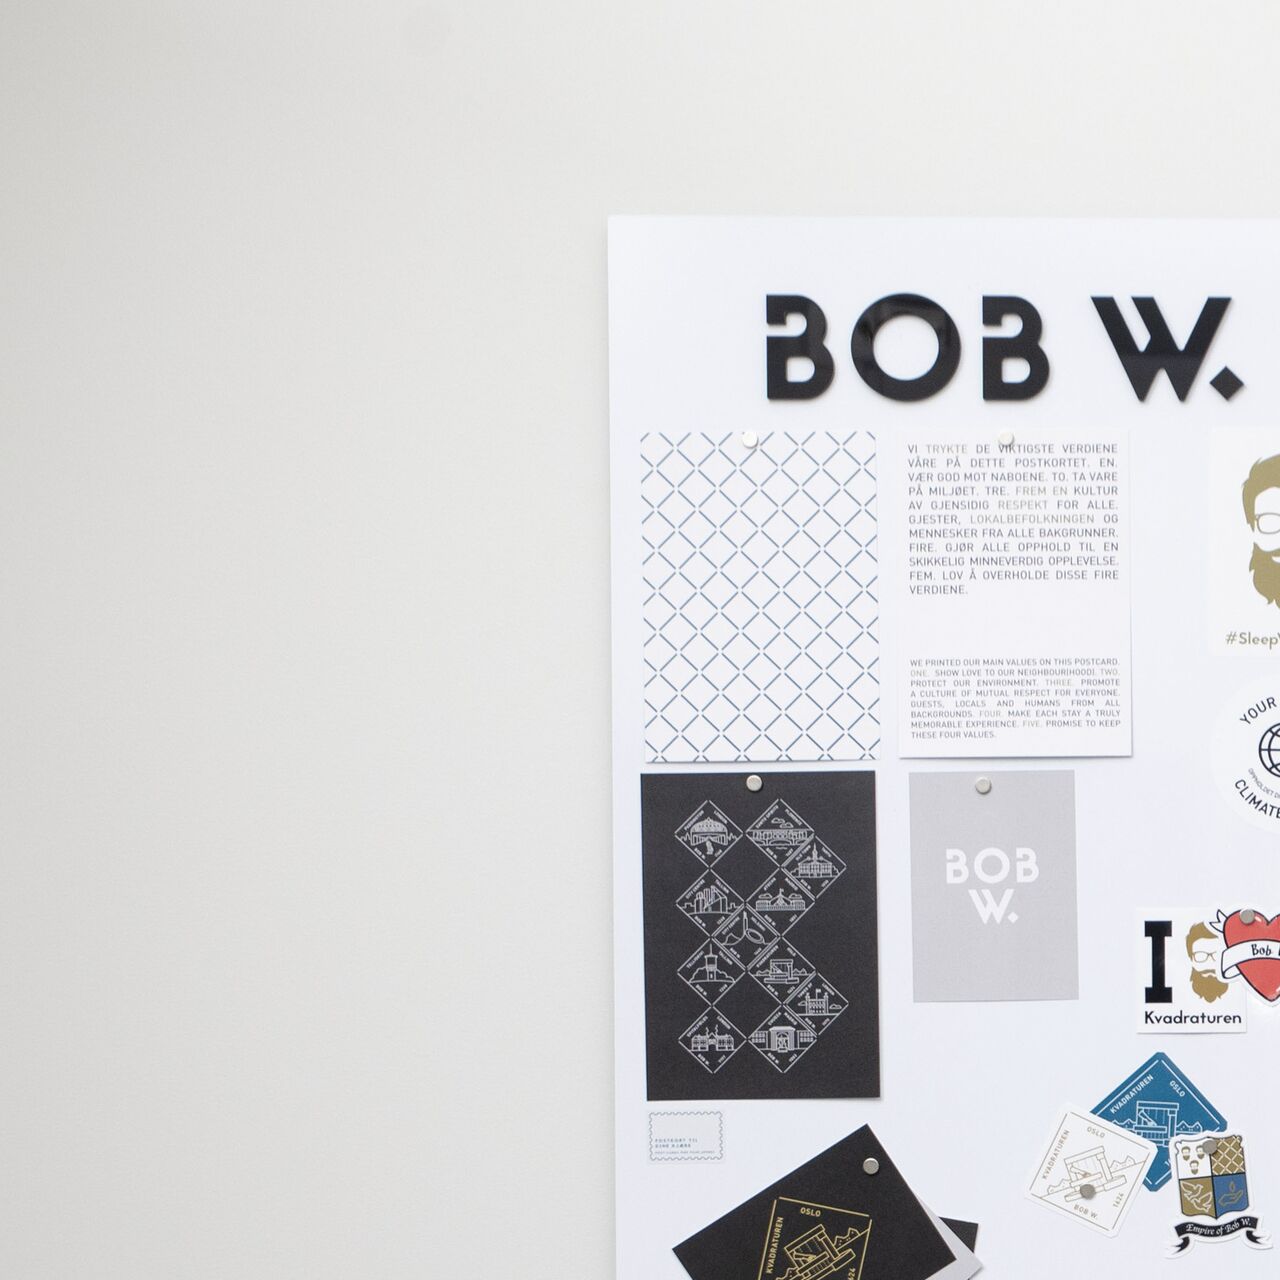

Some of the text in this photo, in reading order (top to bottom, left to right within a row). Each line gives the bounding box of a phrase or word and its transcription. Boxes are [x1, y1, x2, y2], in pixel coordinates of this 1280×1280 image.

[766, 292, 1244, 403] BOB W.
[908, 444, 918, 454] VI
[927, 444, 967, 454] TRYKTE
[976, 444, 990, 454] DE
[1062, 444, 1118, 454] VERDIENE
[907, 458, 937, 468] VÅRE
[946, 458, 961, 468] PÅ
[970, 458, 1005, 468] DETTE
[908, 472, 934, 482] VÆR
[937, 472, 960, 482] GOD
[964, 472, 988, 482] MOT
[1072, 472, 1086, 482] TA
[1089, 472, 1118, 482] VARE
[908, 486, 923, 496] PÅ
[1016, 486, 1047, 496] FREM
[1053, 486, 1068, 496] EN
[1074, 486, 1118, 496] KULTUR
[908, 500, 923, 510] AV
[931, 500, 989, 510] GJENSIDIG
[998, 500, 1047, 510] RESPEKT
[1057, 500, 1079, 510] FOR
[909, 514, 1119, 525] GJESTER, LOKALBEFOLKNINGEN OG
[909, 528, 978, 538] MENNESKER
[982, 528, 1004, 538] FRA
[1007, 528, 1035, 538] ALLE
[945, 542, 974, 552] GJØR
[982, 542, 1010, 552] ALLE
[1018, 542, 1071, 552] OPPHOLD
[1079, 542, 1095, 552] TIL
[1103, 542, 1119, 552] EN
[909, 556, 965, 567] SKIKKELIG
[970, 556, 1044, 567] MINNEVERDIG
[942, 570, 964, 580] LOV
[969, 570, 977, 580] Å
[983, 570, 1050, 580] OVERHOLDE
[1056, 570, 1088, 580] DISSE
[1094, 570, 1119, 580] FIRE
[1239, 696, 1277, 725] YOUR
[945, 847, 1040, 884] BOB
[967, 888, 1019, 925] W.
[1251, 943, 1272, 957] Bob
[1144, 920, 1173, 1004] I
[1144, 1009, 1242, 1025] Kvadraturen
[1109, 1073, 1154, 1114] KVADRATUREN
[1168, 1079, 1186, 1098] OSLO
[1086, 1126, 1106, 1139] OSLO
[1041, 1129, 1070, 1181] KVADRATUREN
[1112, 1191, 1125, 1209] 1624
[800, 1206, 822, 1218] OSLO
[1073, 1203, 1090, 1216] BOB
[1185, 1218, 1251, 1237] Empire of Bob W.
[765, 1216, 785, 1275] KVADRATUREN
